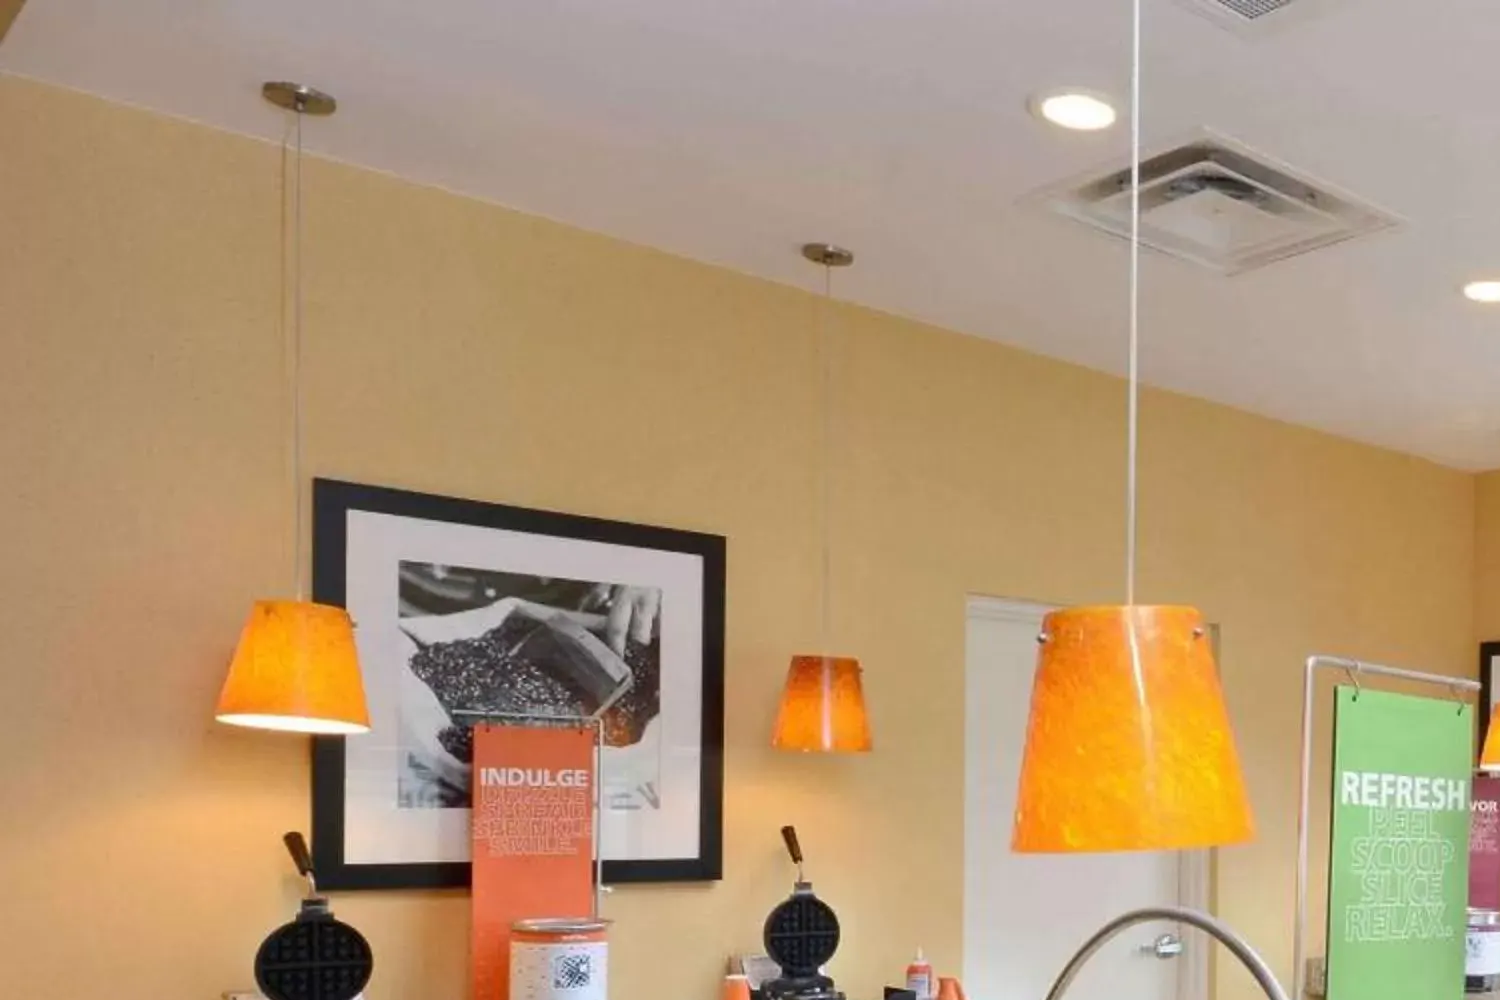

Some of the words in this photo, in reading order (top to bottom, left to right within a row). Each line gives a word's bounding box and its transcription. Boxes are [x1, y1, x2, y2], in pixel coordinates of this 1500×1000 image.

[480, 767, 590, 787] INDULGE
[1341, 771, 1467, 811] REFRESH
[1369, 805, 1440, 841] PEEL
[1351, 836, 1455, 875] SCOOP
[1361, 872, 1443, 907] SLICE
[1345, 903, 1455, 942] RELAX.
